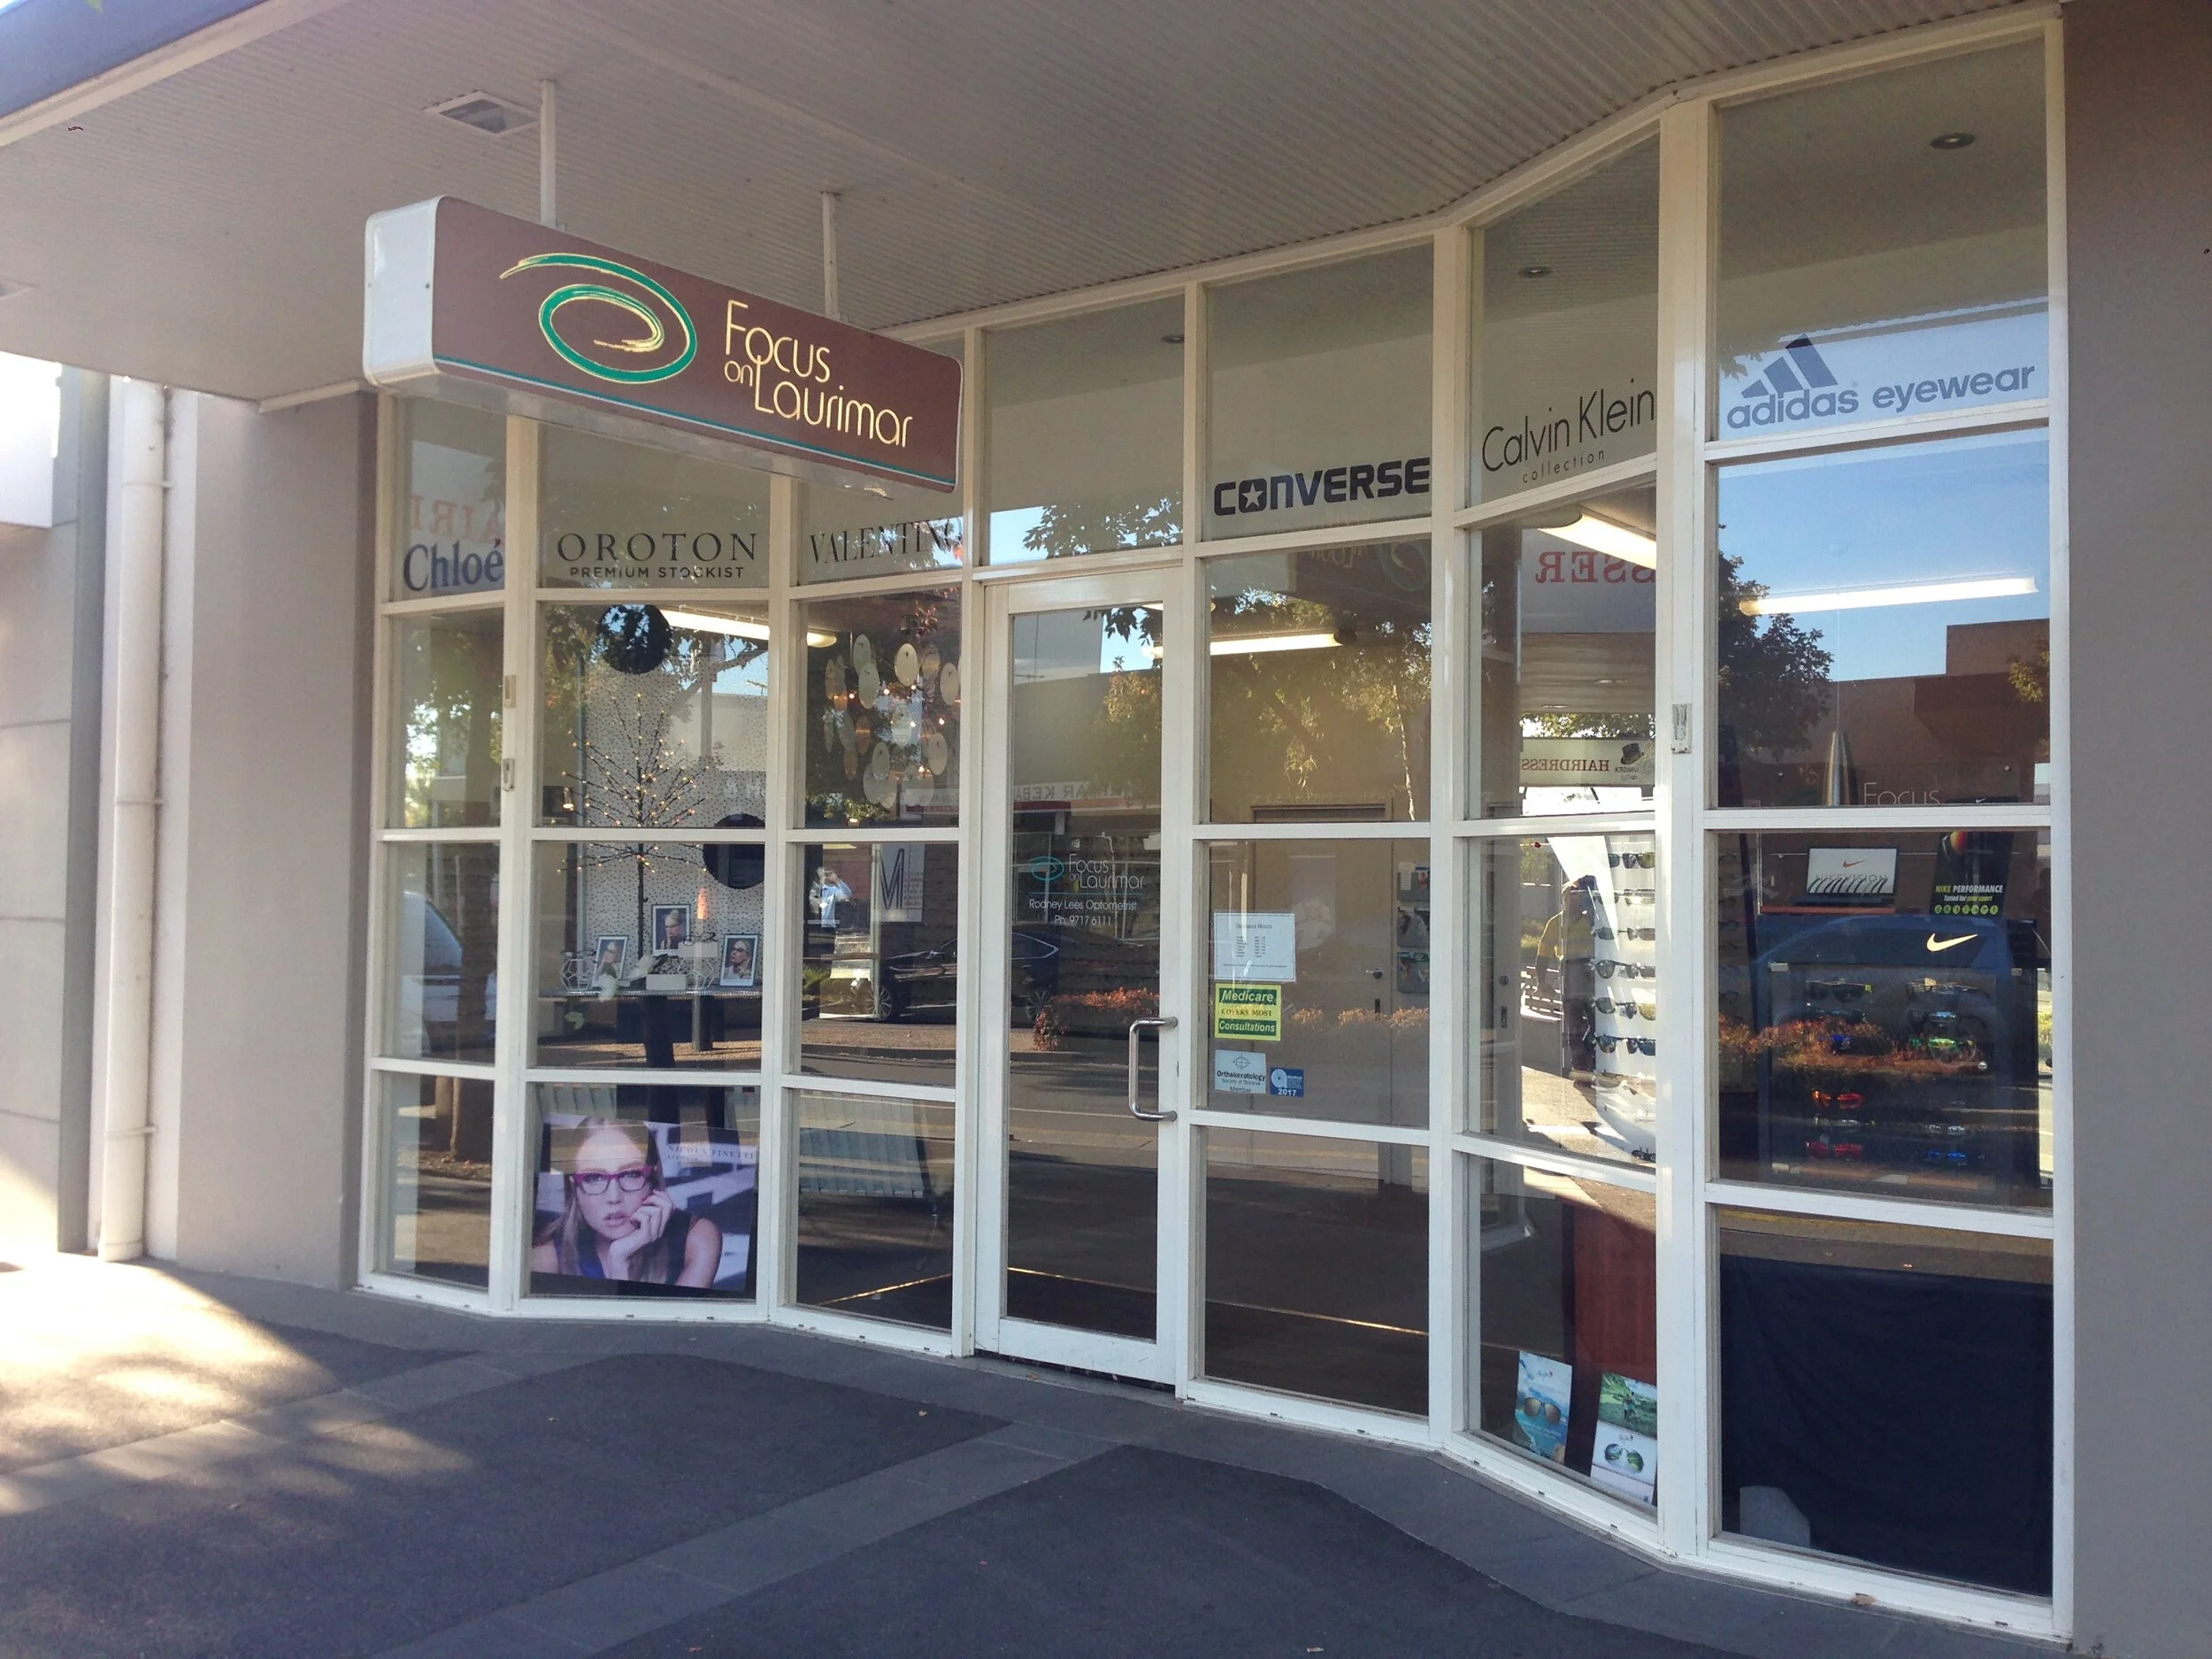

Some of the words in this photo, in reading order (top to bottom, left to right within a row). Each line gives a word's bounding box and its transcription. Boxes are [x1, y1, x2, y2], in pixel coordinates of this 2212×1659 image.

[726, 300, 831, 382] Focus
[724, 360, 753, 387] on
[754, 355, 913, 448] Laurimar
[1727, 388, 1859, 429] adidas
[1871, 365, 2035, 413] eyewear
[1481, 406, 1571, 472] Calvin
[1578, 378, 1655, 444] Klein
[1522, 447, 1606, 484] collection
[1214, 456, 1431, 517] CONVERSE
[557, 532, 757, 562] OROTON
[403, 538, 503, 592] Chloé
[570, 566, 649, 578] PREMIUM
[657, 566, 744, 579] STOCKIST
[1069, 854, 1110, 873] Focus
[1029, 899, 1063, 910] Rodney
[1064, 900, 1084, 910] Lees
[1953, 885, 2003, 894] PERFORMANCE
[1222, 990, 1274, 1002] Medicare
[1219, 1020, 1276, 1033] Consultations
